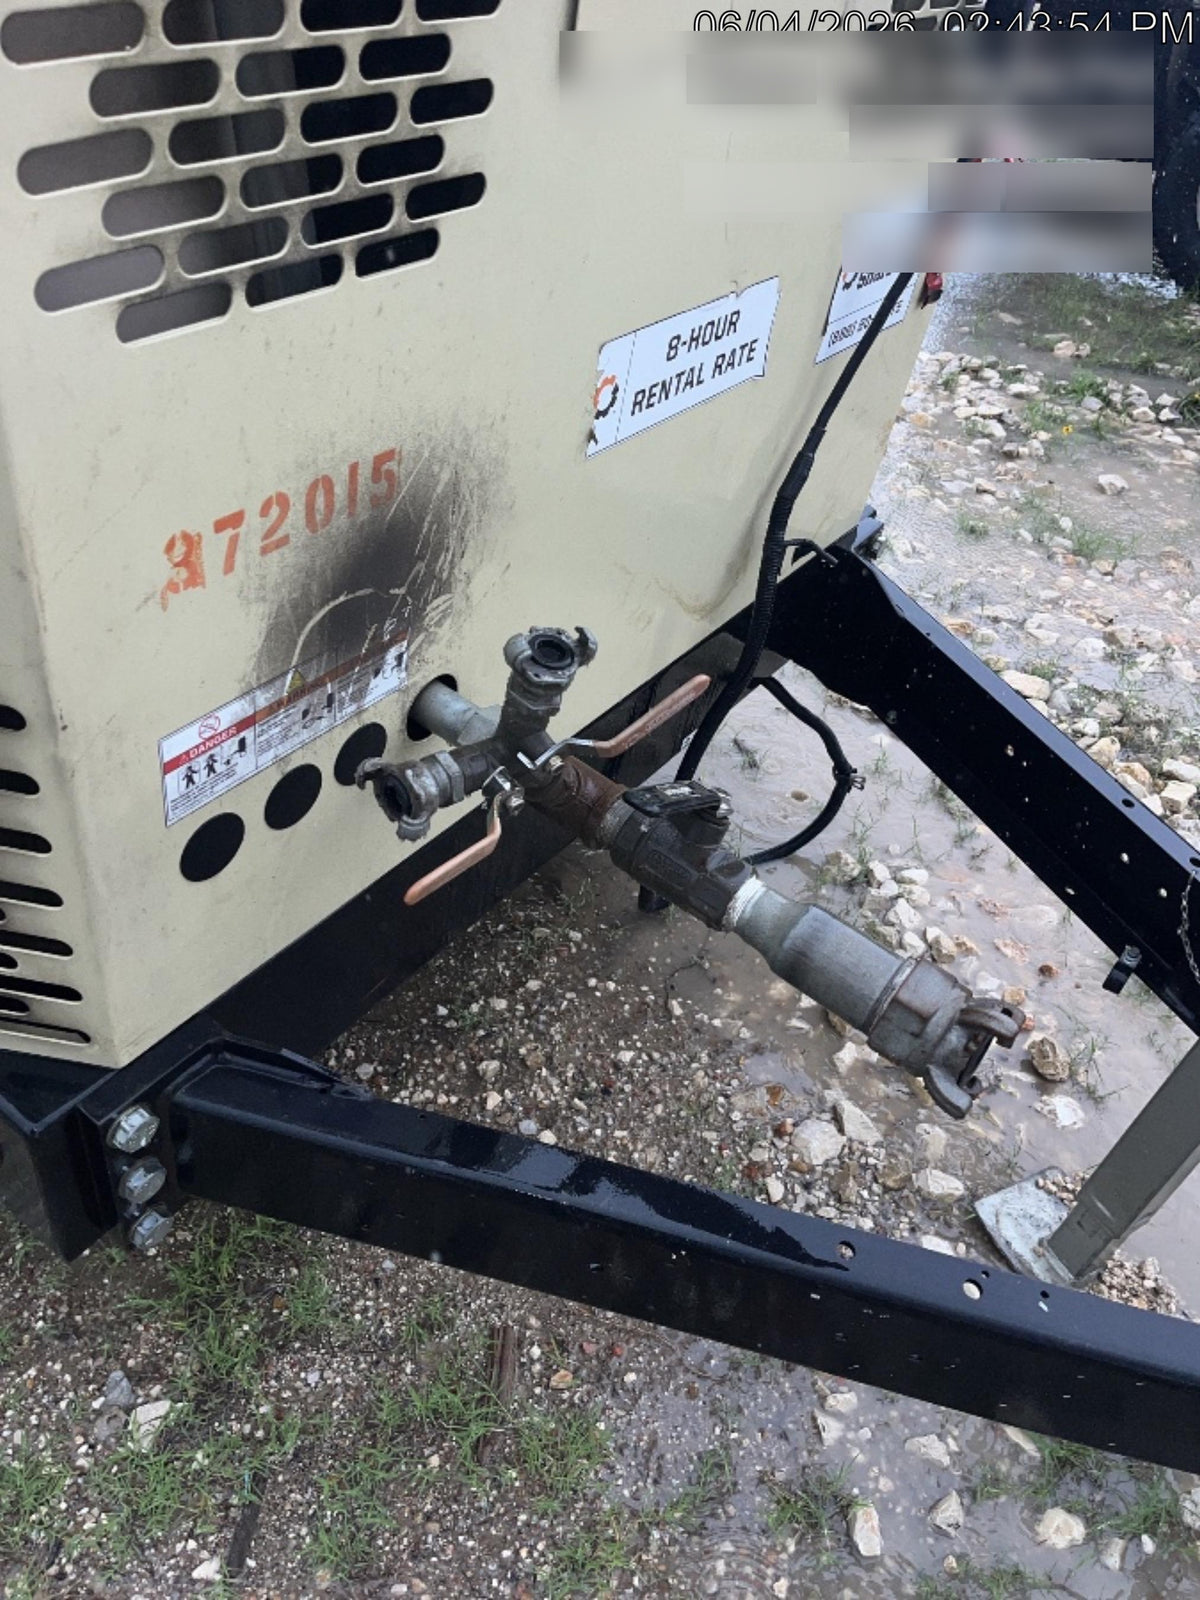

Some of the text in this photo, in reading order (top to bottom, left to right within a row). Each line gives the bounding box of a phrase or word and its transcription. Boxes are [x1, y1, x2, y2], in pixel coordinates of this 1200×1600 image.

[666, 309, 741, 362] 8-HOUR
[630, 337, 758, 416] RENTAL RATE
[189, 727, 238, 759] DANGER
